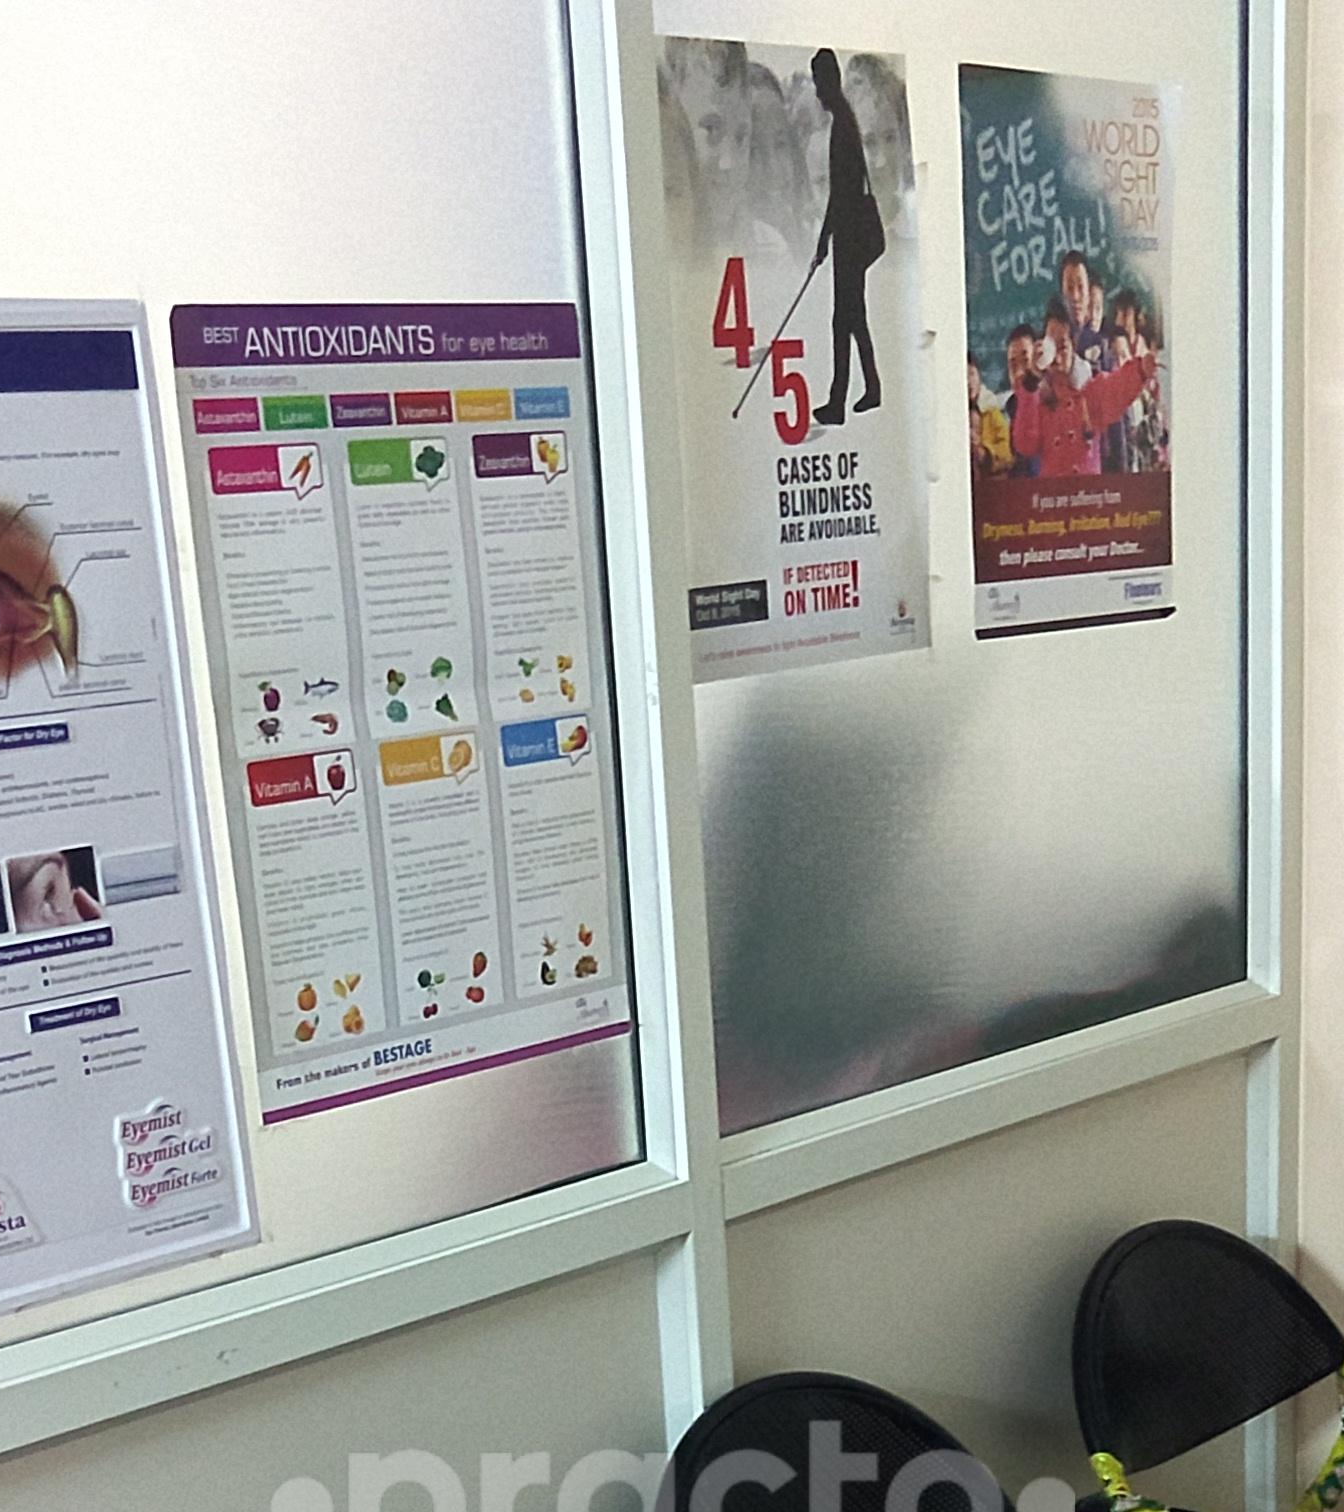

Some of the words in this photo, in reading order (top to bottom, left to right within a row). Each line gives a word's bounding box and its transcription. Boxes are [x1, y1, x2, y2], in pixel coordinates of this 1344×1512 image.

[976, 117, 1037, 189] EYE
[1083, 118, 1160, 158] WORLD
[1104, 159, 1160, 195] SIGHT
[978, 168, 1059, 236] CARE
[1119, 197, 1160, 231] DAY
[991, 234, 1053, 292] FOR
[1052, 198, 1106, 265] ALL!
[713, 257, 754, 368] 4
[203, 326, 239, 345] BEST
[244, 324, 435, 358] ANTIOXIDANTS
[442, 333, 465, 353] for
[469, 333, 496, 356] eye
[500, 330, 549, 352] health
[771, 339, 810, 445] 5
[439, 404, 449, 417] A
[777, 454, 832, 486] CASES
[838, 452, 859, 480] OF
[779, 483, 872, 518] BLINDNESS
[1040, 494, 1055, 512] you
[1055, 494, 1068, 506] are
[1070, 491, 1103, 509] suffering
[1104, 489, 1121, 504] from
[780, 522, 805, 545] ARE
[808, 514, 881, 541] AVOIDABLE,
[999, 549, 1021, 566] then
[1022, 547, 1053, 568] please
[1054, 542, 1087, 561] consult
[1088, 545, 1109, 562] your
[783, 567, 794, 585] IF
[797, 561, 850, 584] DETECTED
[784, 590, 806, 617] ON
[811, 560, 860, 613] TIME!
[508, 740, 546, 758] Vitamin
[548, 738, 556, 752] E
[386, 758, 428, 776] Vitamin
[255, 780, 300, 799] Vitamin
[302, 778, 314, 793] A
[276, 1075, 301, 1090] From
[304, 1071, 321, 1083] the
[325, 1062, 359, 1078] makers
[362, 1057, 370, 1068] of
[373, 1037, 432, 1066] BESTAGE
[121, 1110, 182, 1141] Eyemist
[126, 1140, 187, 1173] Eyemist
[189, 1134, 211, 1153] Gel
[131, 1171, 189, 1203] Eyemist
